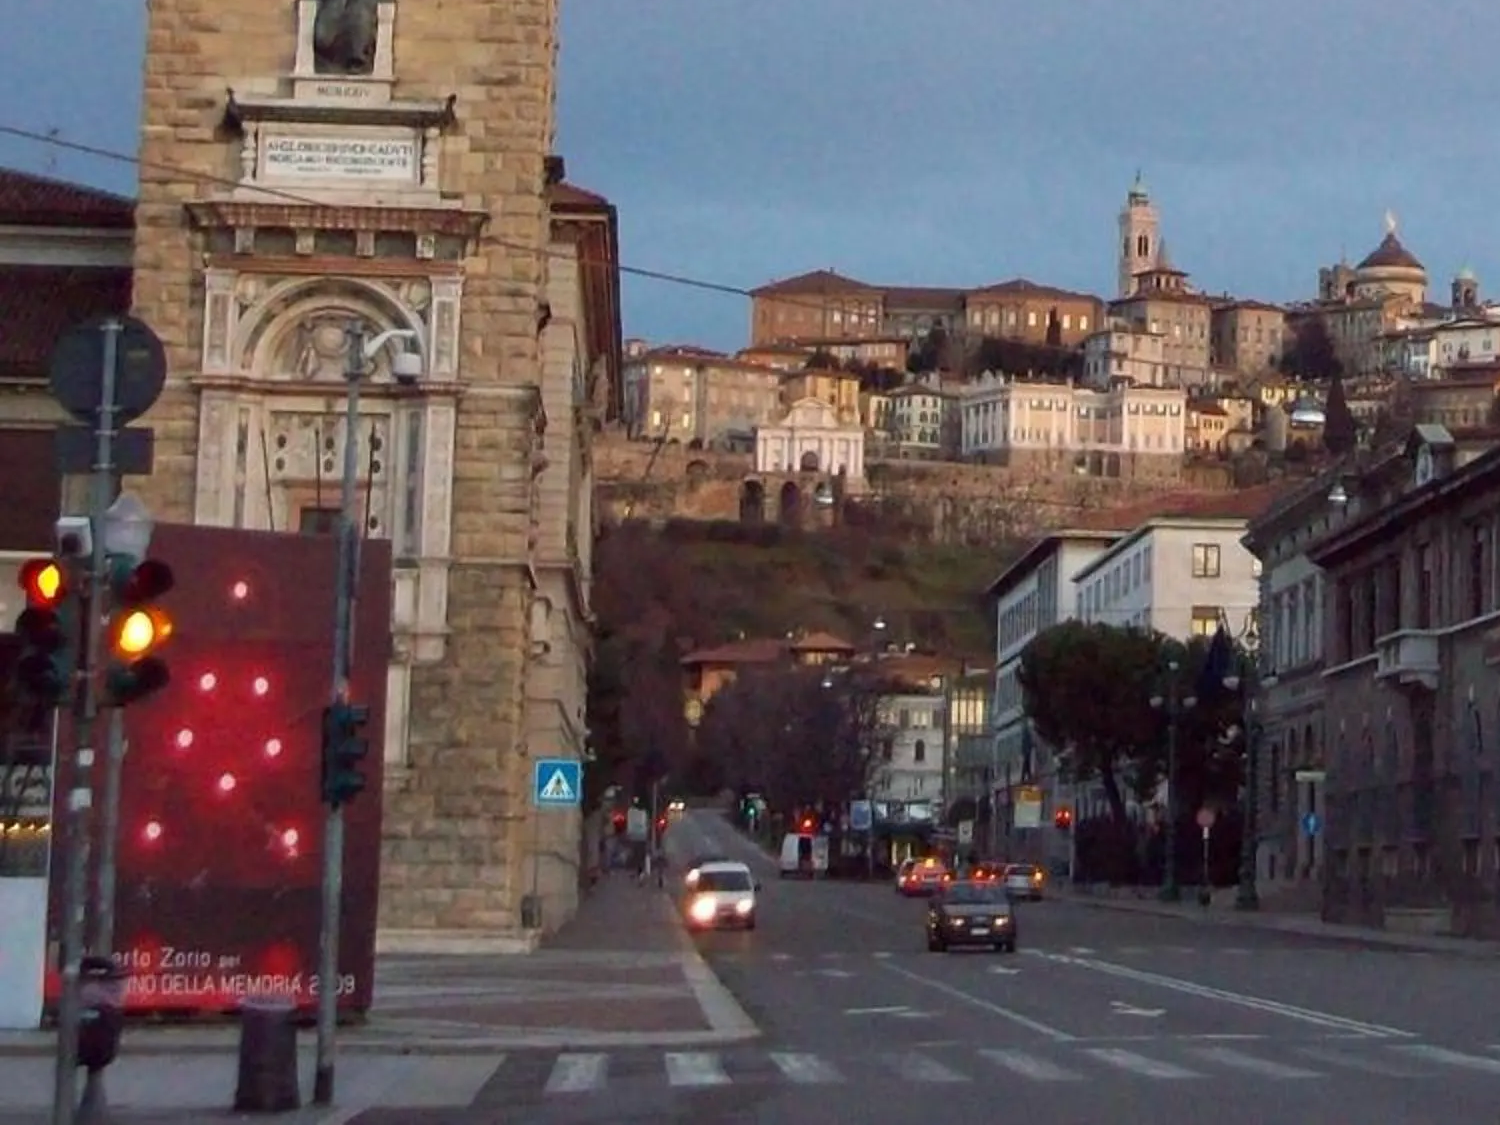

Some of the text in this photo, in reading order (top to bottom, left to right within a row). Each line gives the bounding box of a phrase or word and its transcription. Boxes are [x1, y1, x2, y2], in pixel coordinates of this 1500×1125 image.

[160, 946, 212, 969] Zorio
[161, 974, 217, 995] DELLA
[221, 973, 303, 996] MEMORIA
[309, 973, 356, 996] 209
